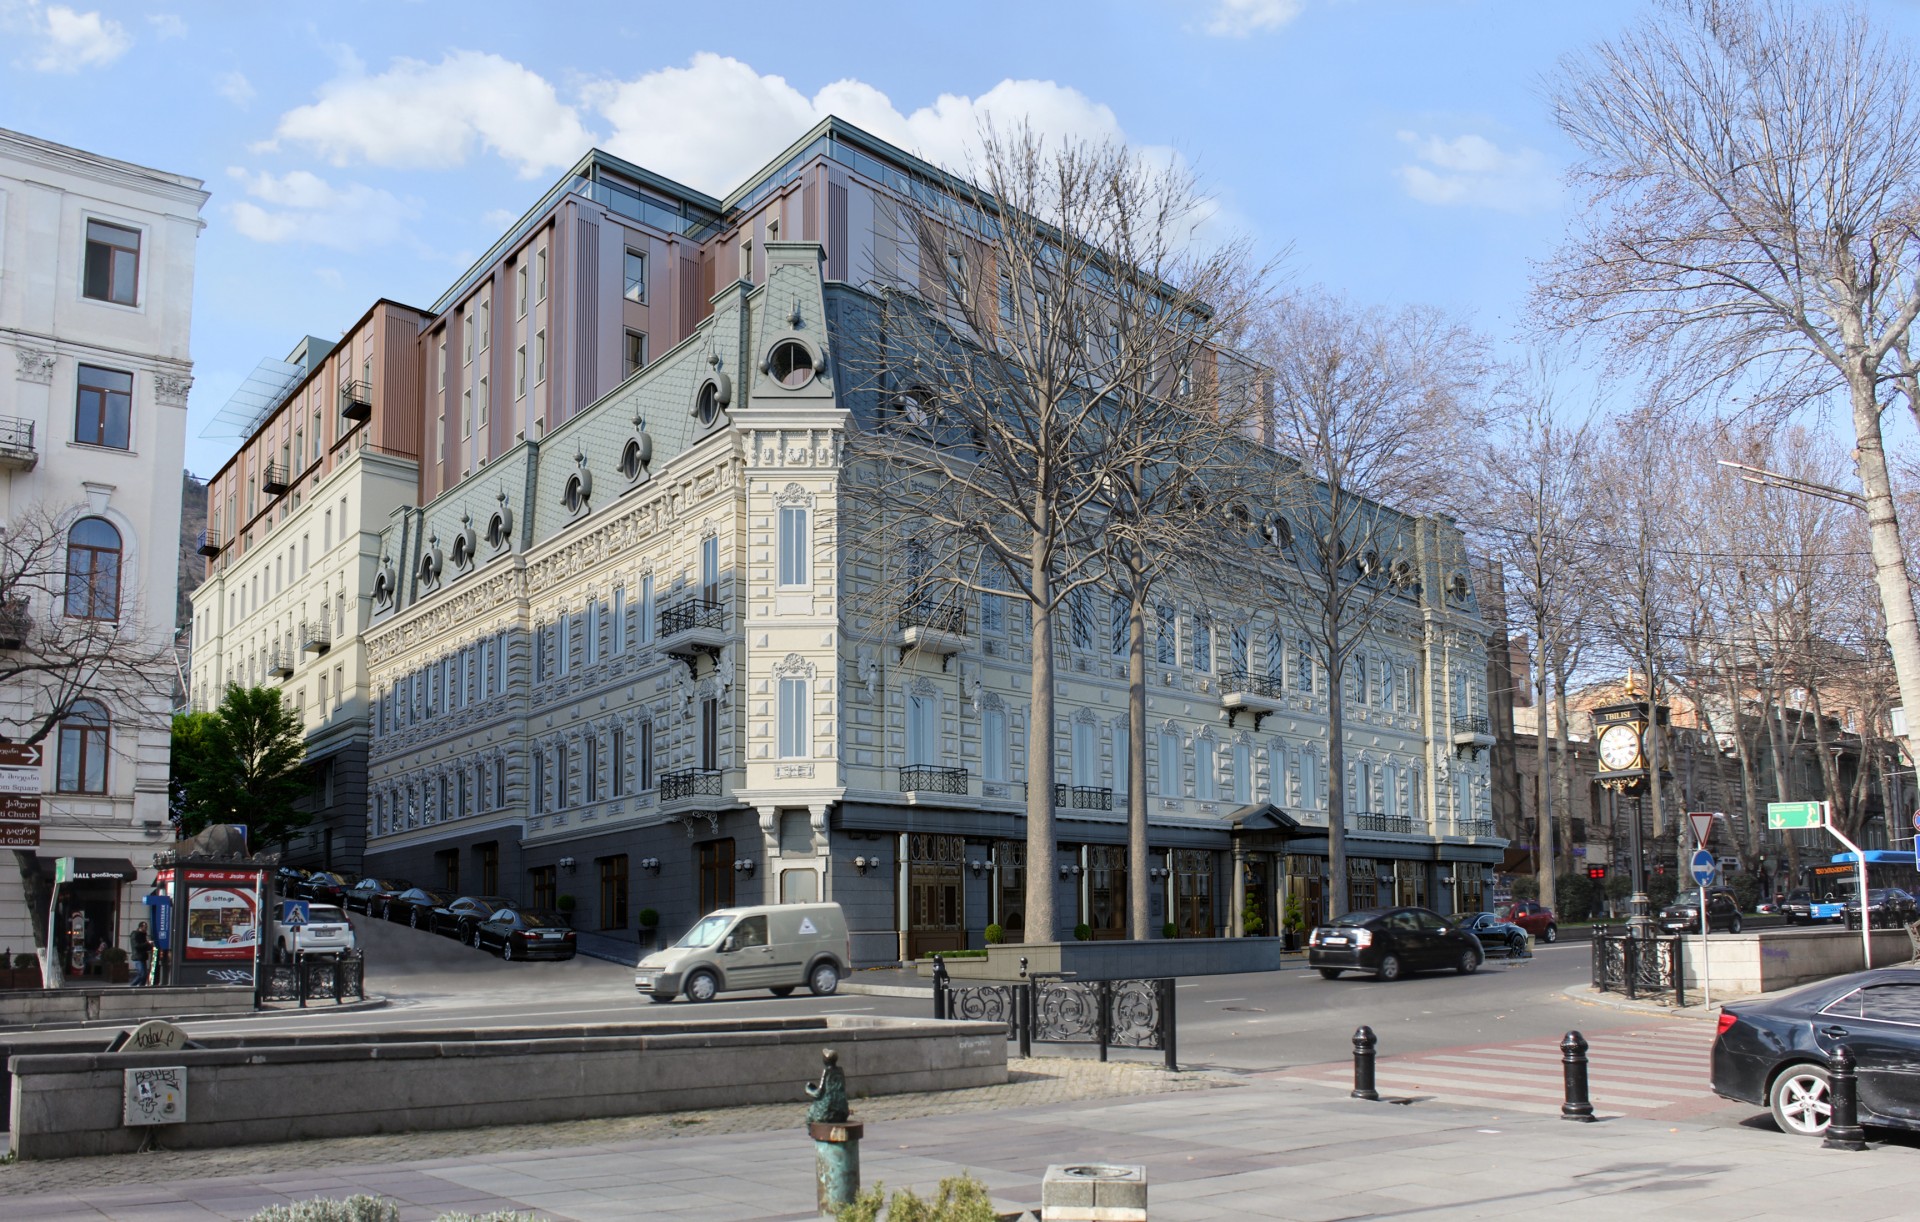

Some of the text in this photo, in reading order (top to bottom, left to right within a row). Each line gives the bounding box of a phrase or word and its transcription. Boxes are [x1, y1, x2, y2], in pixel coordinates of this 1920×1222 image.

[1604, 710, 1632, 721] TBILISI
[12, 784, 39, 792] Square
[7, 810, 37, 819] Church
[7, 837, 36, 846] Gallery
